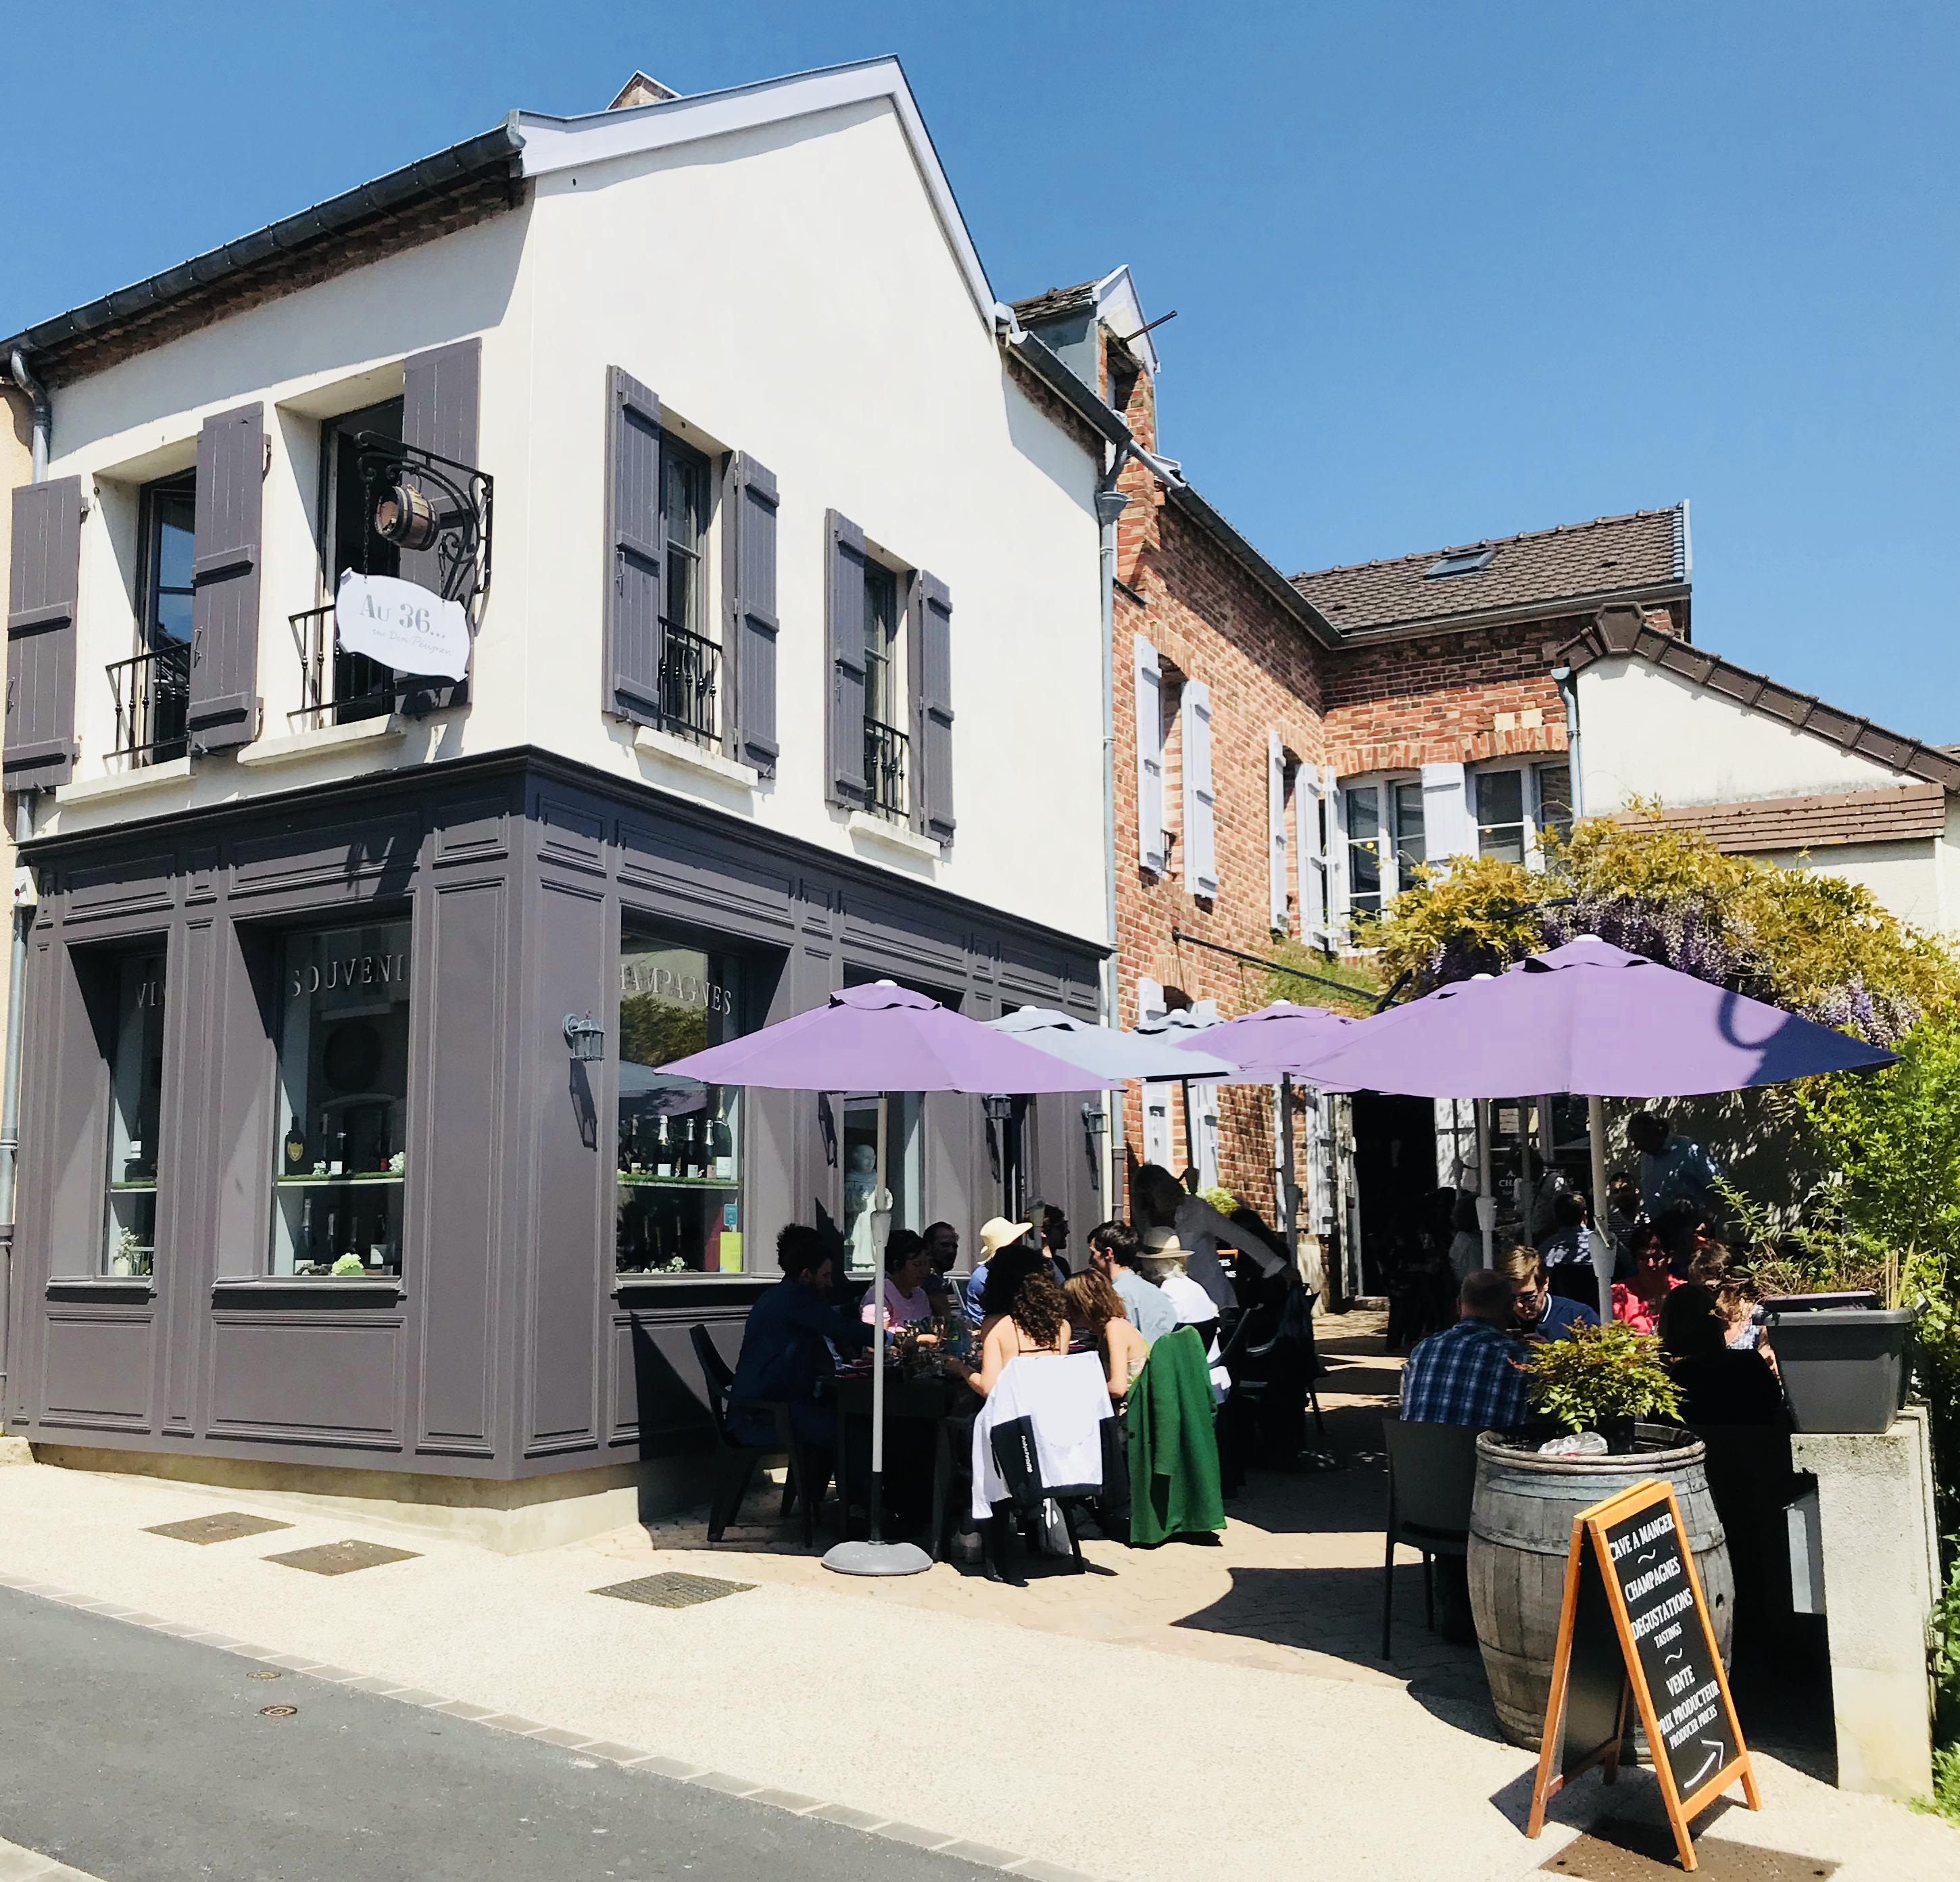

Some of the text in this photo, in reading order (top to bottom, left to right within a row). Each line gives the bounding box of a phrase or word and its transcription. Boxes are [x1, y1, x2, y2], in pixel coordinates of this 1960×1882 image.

[360, 594, 391, 622] Au
[372, 629, 386, 637] rue
[389, 630, 408, 642] Dom
[1609, 1513, 1675, 1562] CAVE A MANGER
[1625, 1556, 1681, 1602] CHAMPAGNES
[1630, 1587, 1693, 1640] DEGUSTATIONS
[1654, 1622, 1682, 1649] TASTINGS
[1665, 1665, 1695, 1696] VENTE
[1657, 1680, 1720, 1735] PRIX PRODUCTEUR
[1669, 1704, 1717, 1750] PRODUCER PRICES
